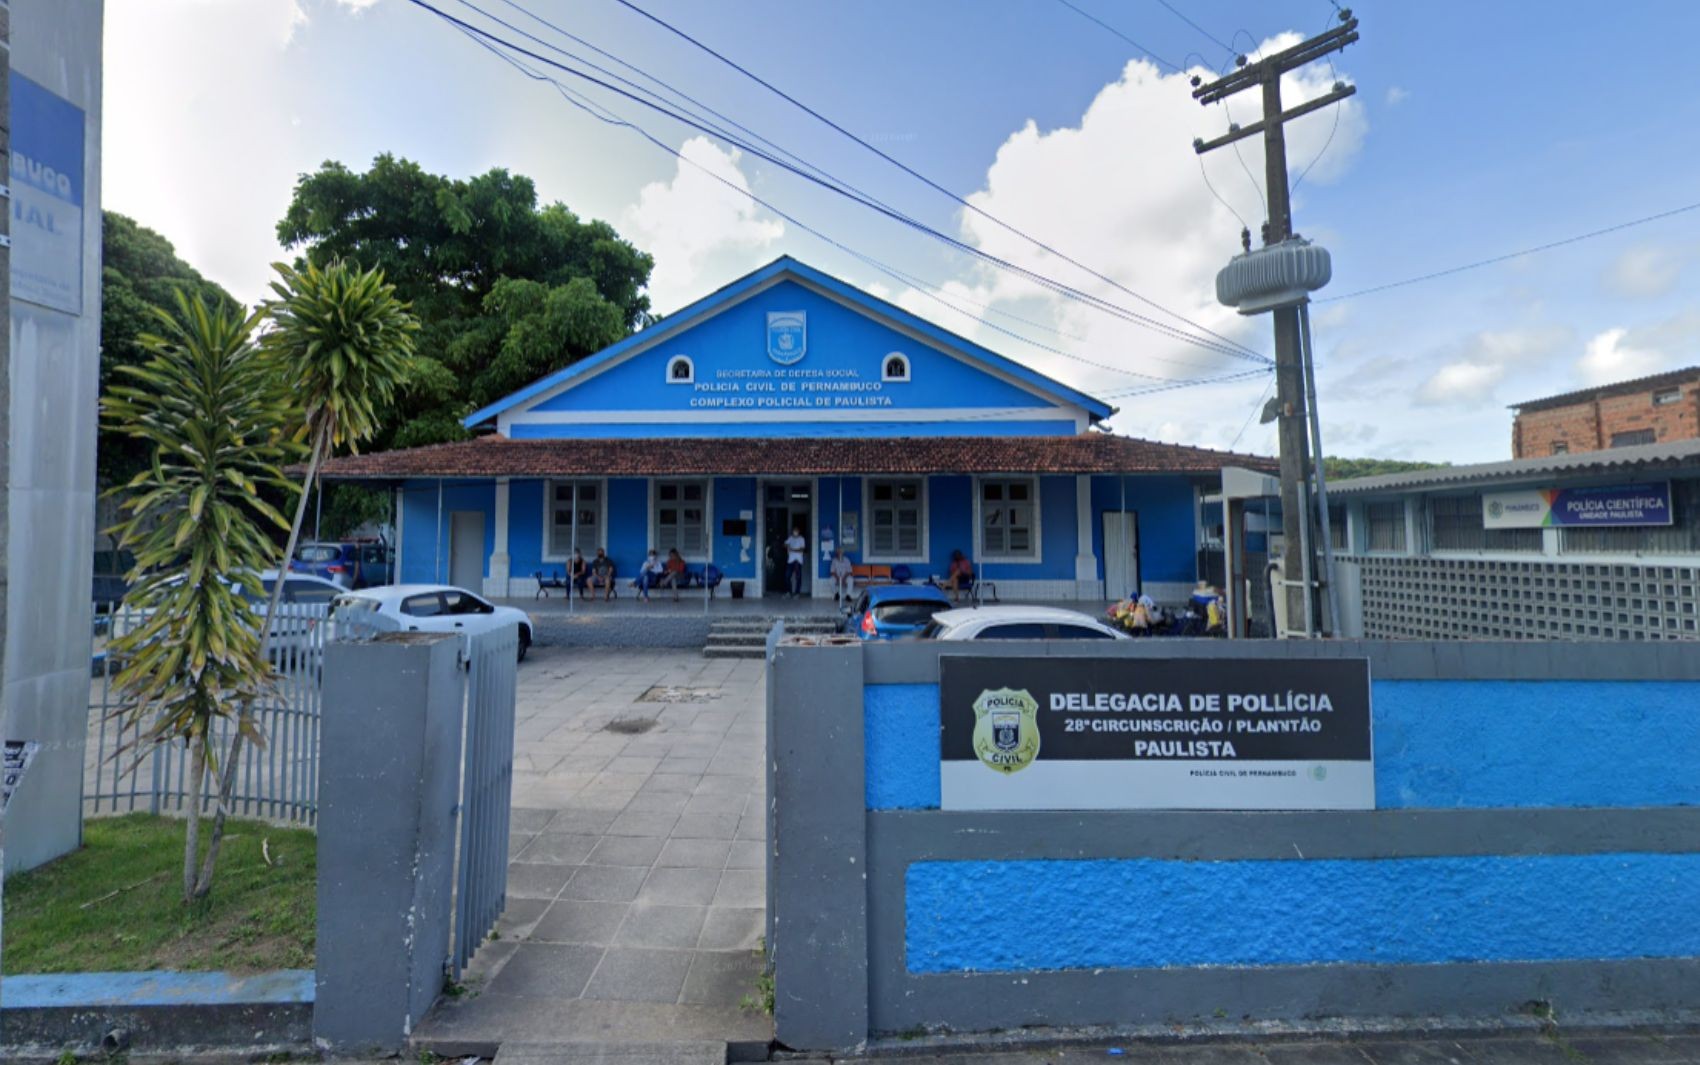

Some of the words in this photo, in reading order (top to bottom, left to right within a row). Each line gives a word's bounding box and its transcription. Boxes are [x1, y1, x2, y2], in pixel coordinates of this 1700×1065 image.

[11, 150, 71, 199] BUCO
[14, 199, 63, 235] IAL
[716, 369, 771, 378] SECRETARIA
[774, 369, 787, 378] DE
[788, 369, 823, 378] DEFESA
[826, 369, 859, 377] SOCIAL
[746, 382, 775, 392] CIVIL
[781, 382, 796, 391] DE
[801, 382, 882, 391] PERNAMBUCO
[690, 397, 754, 407] COMPLEXO
[758, 397, 810, 407] POLICIAL
[816, 397, 830, 406] DE
[835, 397, 892, 406] PAULISTA
[1567, 497, 1604, 512] POLÍCIA
[1606, 496, 1663, 511] CIENTÍFICA
[1050, 693, 1183, 711] DELEGACIA
[1190, 694, 1220, 712] DE
[1092, 717, 1223, 735] CIRCUNSCRIÇÃO
[1135, 740, 1236, 757] PAULISTA
